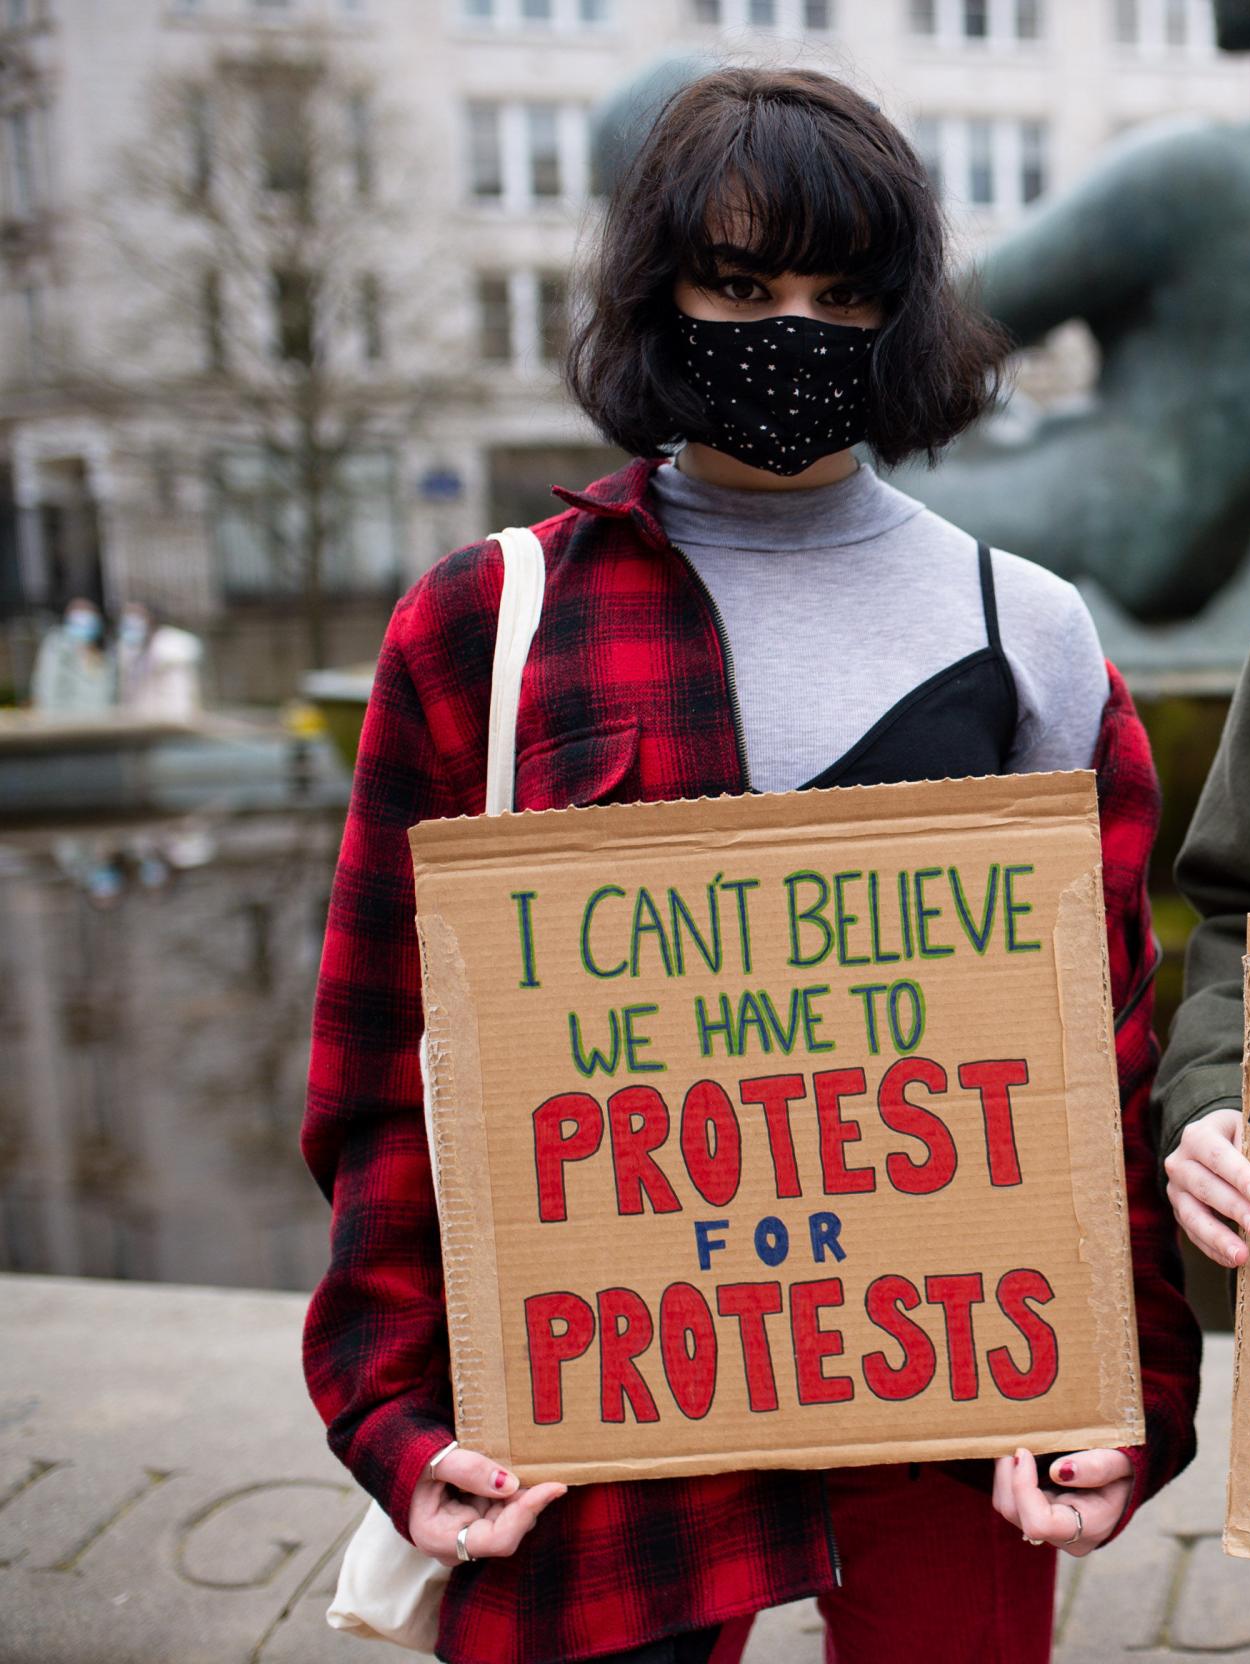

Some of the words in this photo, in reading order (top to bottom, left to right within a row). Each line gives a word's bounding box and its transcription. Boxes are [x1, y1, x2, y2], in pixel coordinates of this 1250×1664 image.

[512, 891, 541, 989] I
[580, 872, 761, 979] CAN'T
[784, 864, 1043, 968] BELIEVE
[569, 1003, 665, 1077] WE
[695, 984, 834, 1056] HAVE
[850, 979, 927, 1055] TO
[532, 1057, 1030, 1222] PROTEST
[695, 1211, 847, 1271] FOR
[523, 1268, 1060, 1425] PROTESTS
